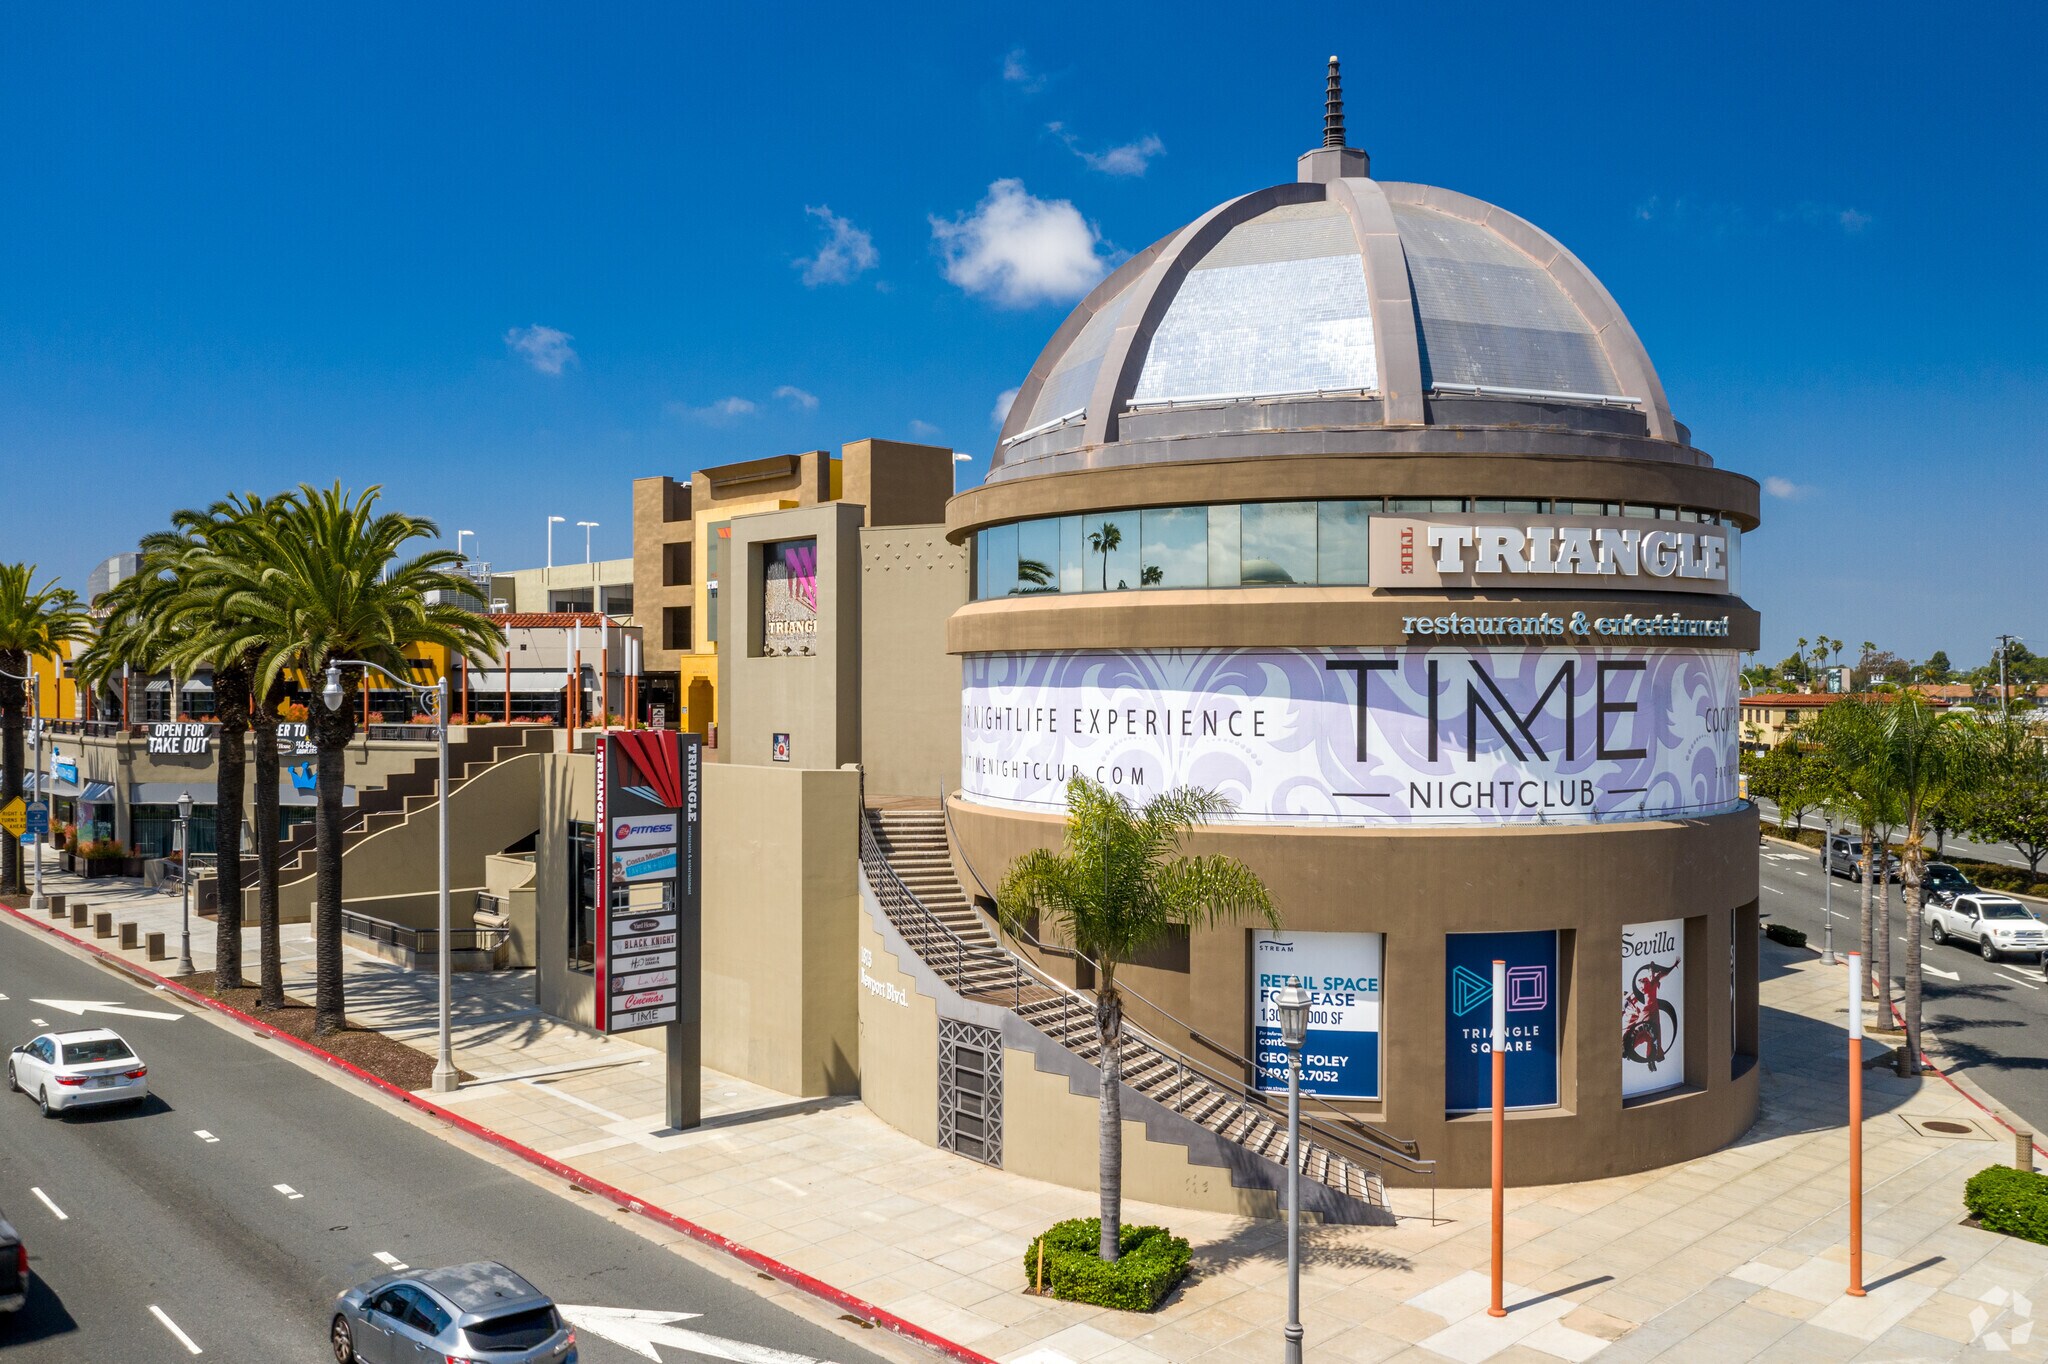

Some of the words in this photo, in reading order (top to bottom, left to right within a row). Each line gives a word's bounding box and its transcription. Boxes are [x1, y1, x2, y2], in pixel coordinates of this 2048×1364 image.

[1401, 527, 1413, 574] THE
[1428, 526, 1726, 581] TRIANGLE
[1402, 613, 1563, 636] restaurants
[1569, 611, 1591, 636] &
[1595, 613, 1730, 638] entertainment
[1326, 660, 1647, 762] TIME
[974, 706, 1057, 732] NIGHTLIFE
[1074, 708, 1266, 738] EXPERIENCE
[155, 724, 182, 737] OPEN
[184, 724, 205, 737] FOR
[276, 724, 291, 737] ER
[294, 724, 307, 737] TO
[149, 737, 180, 753] TAKE
[183, 737, 209, 753] OUT
[688, 743, 697, 822] TRIANGLE
[1409, 780, 1595, 809] NIGHTCLUB
[630, 824, 673, 834] FITNESS
[626, 857, 646, 866] Costa
[624, 938, 648, 949] BLACK
[651, 934, 675, 945] KNIGHT
[1621, 930, 1675, 958] Sevilla
[1323, 976, 1378, 992] SPACE
[624, 993, 664, 1009] Cinemas
[886, 982, 908, 1007] Blvd.
[1309, 992, 1355, 1006] EASE
[630, 1010, 659, 1022] TIME
[1331, 1011, 1344, 1025] SF
[1259, 1037, 1287, 1047] conta
[1471, 1040, 1532, 1054] SQARE
[1259, 1051, 1303, 1065] GEO
[1306, 1054, 1349, 1067] FOLEY
[1259, 1066, 1339, 1083] 949.96.7052
